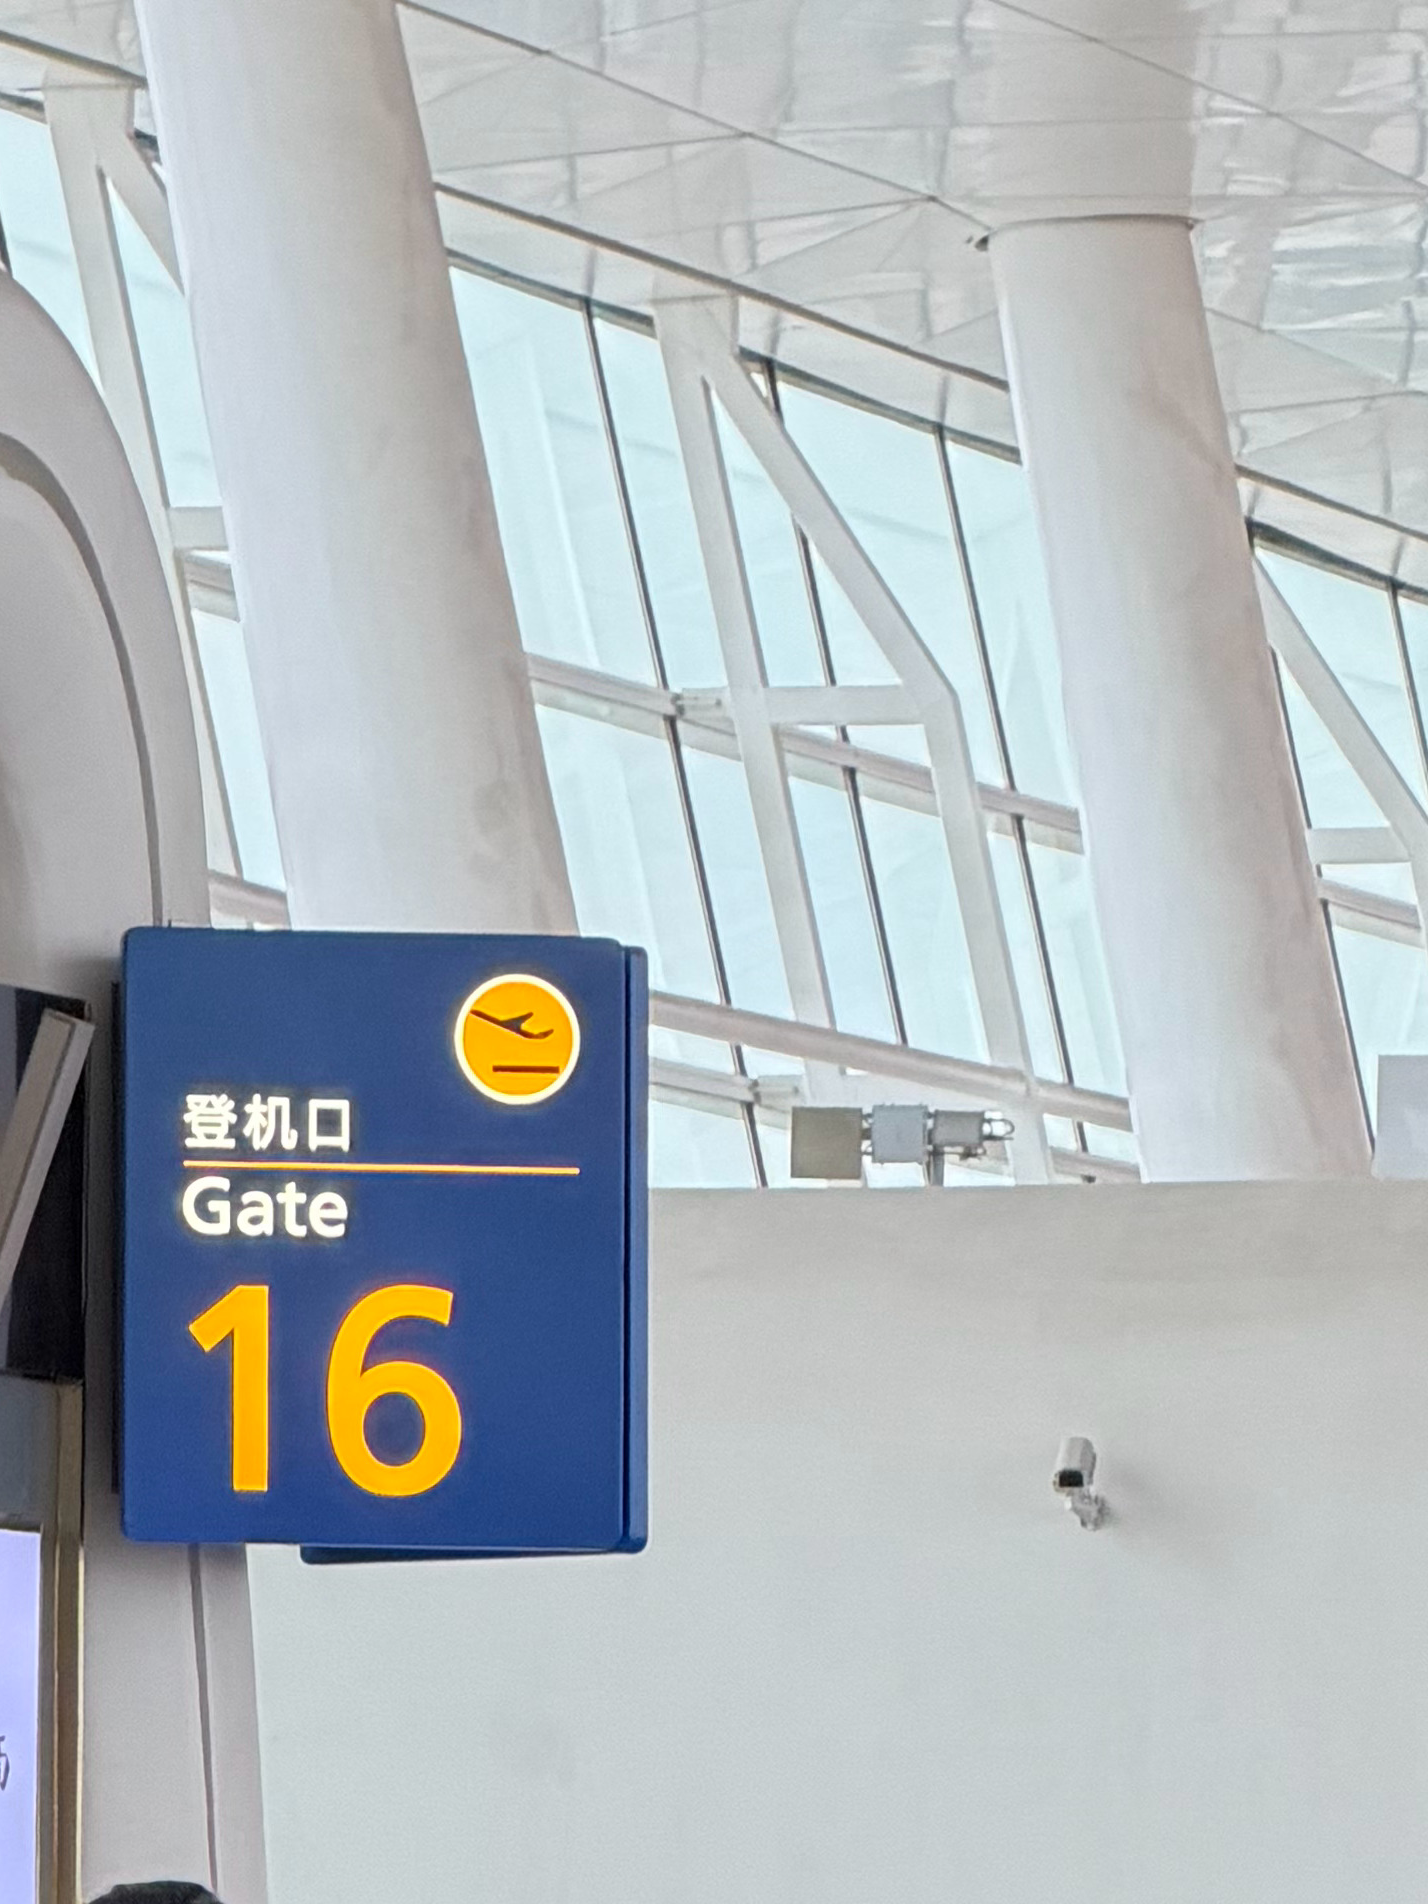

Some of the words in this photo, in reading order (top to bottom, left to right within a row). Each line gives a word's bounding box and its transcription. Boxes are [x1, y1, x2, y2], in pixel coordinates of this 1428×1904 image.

[182, 1092, 351, 1153] 登机口
[182, 1176, 349, 1239] Gate
[188, 1284, 463, 1497] 16
